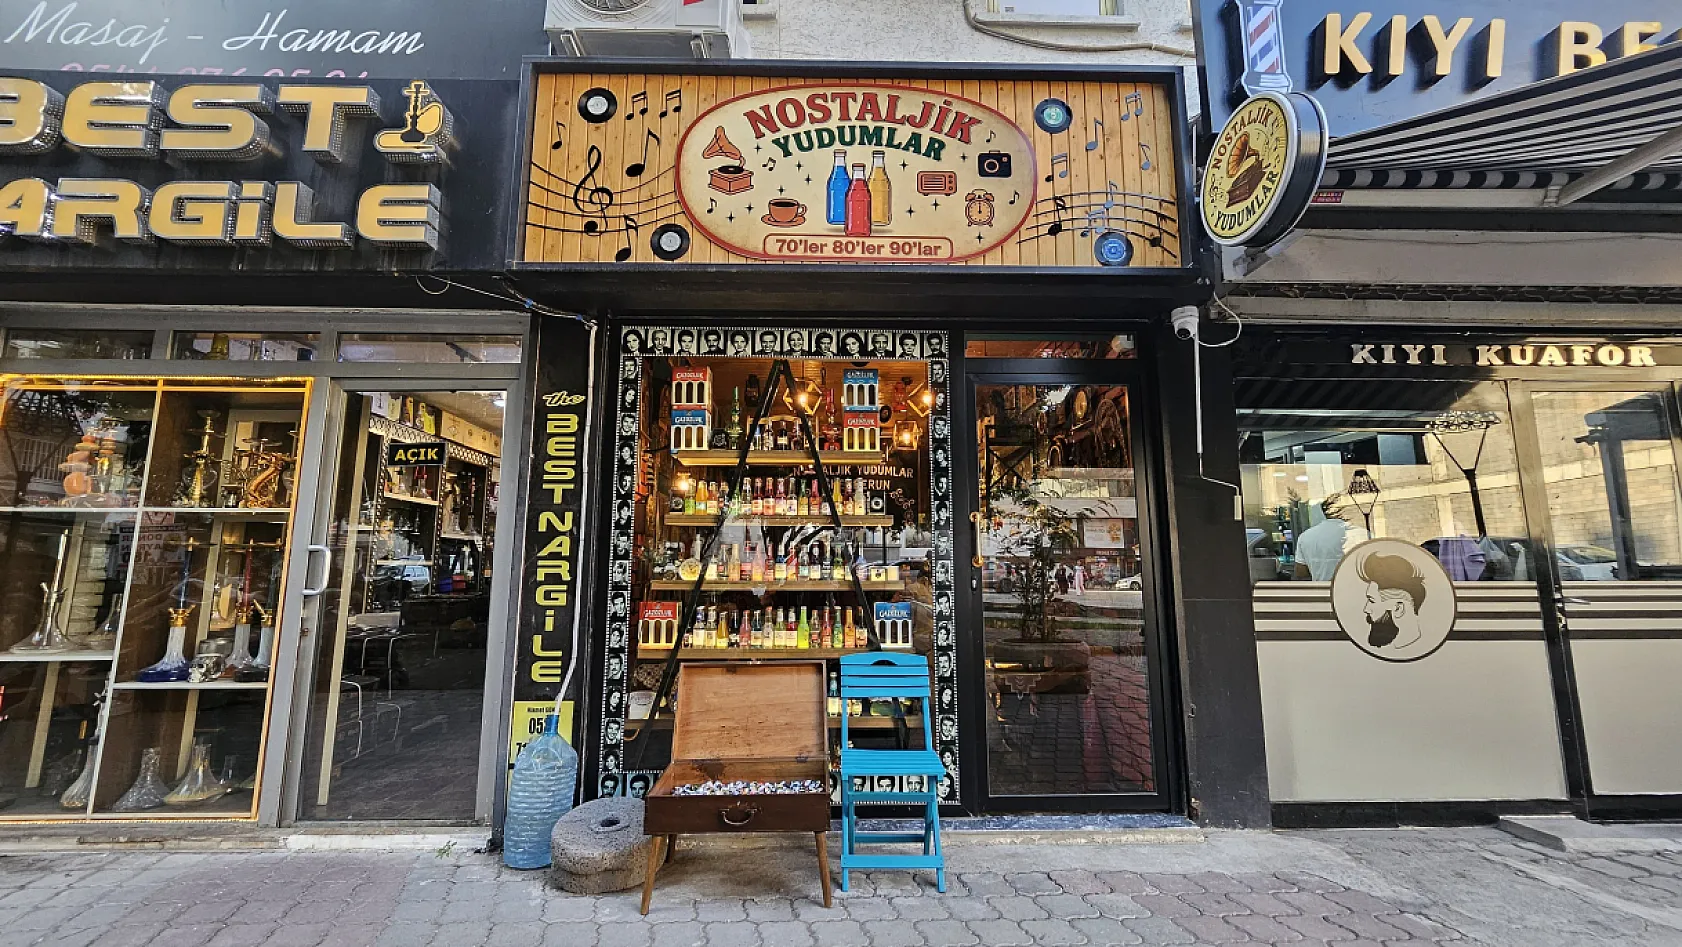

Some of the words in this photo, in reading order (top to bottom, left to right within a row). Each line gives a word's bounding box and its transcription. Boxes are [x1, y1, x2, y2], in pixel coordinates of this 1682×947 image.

[4, 1, 170, 65] Masaj
[222, 9, 424, 55] Hamam
[1323, 12, 1506, 78] KIYI
[1558, 21, 1682, 76] BE
[743, 91, 982, 145] NOSTALJİK
[771, 125, 947, 161] YUDUMLAR
[1214, 170, 1280, 231] YUDUMLAR
[775, 239, 827, 254] 70'ler
[832, 240, 885, 255] 80'ler
[888, 241, 942, 256] 90'lar
[1351, 344, 1447, 365] KIYI
[394, 447, 439, 464] AÇIK
[541, 413, 579, 505] BEST
[857, 464, 914, 479] YUDUMLAR
[528, 717, 547, 734] 05
